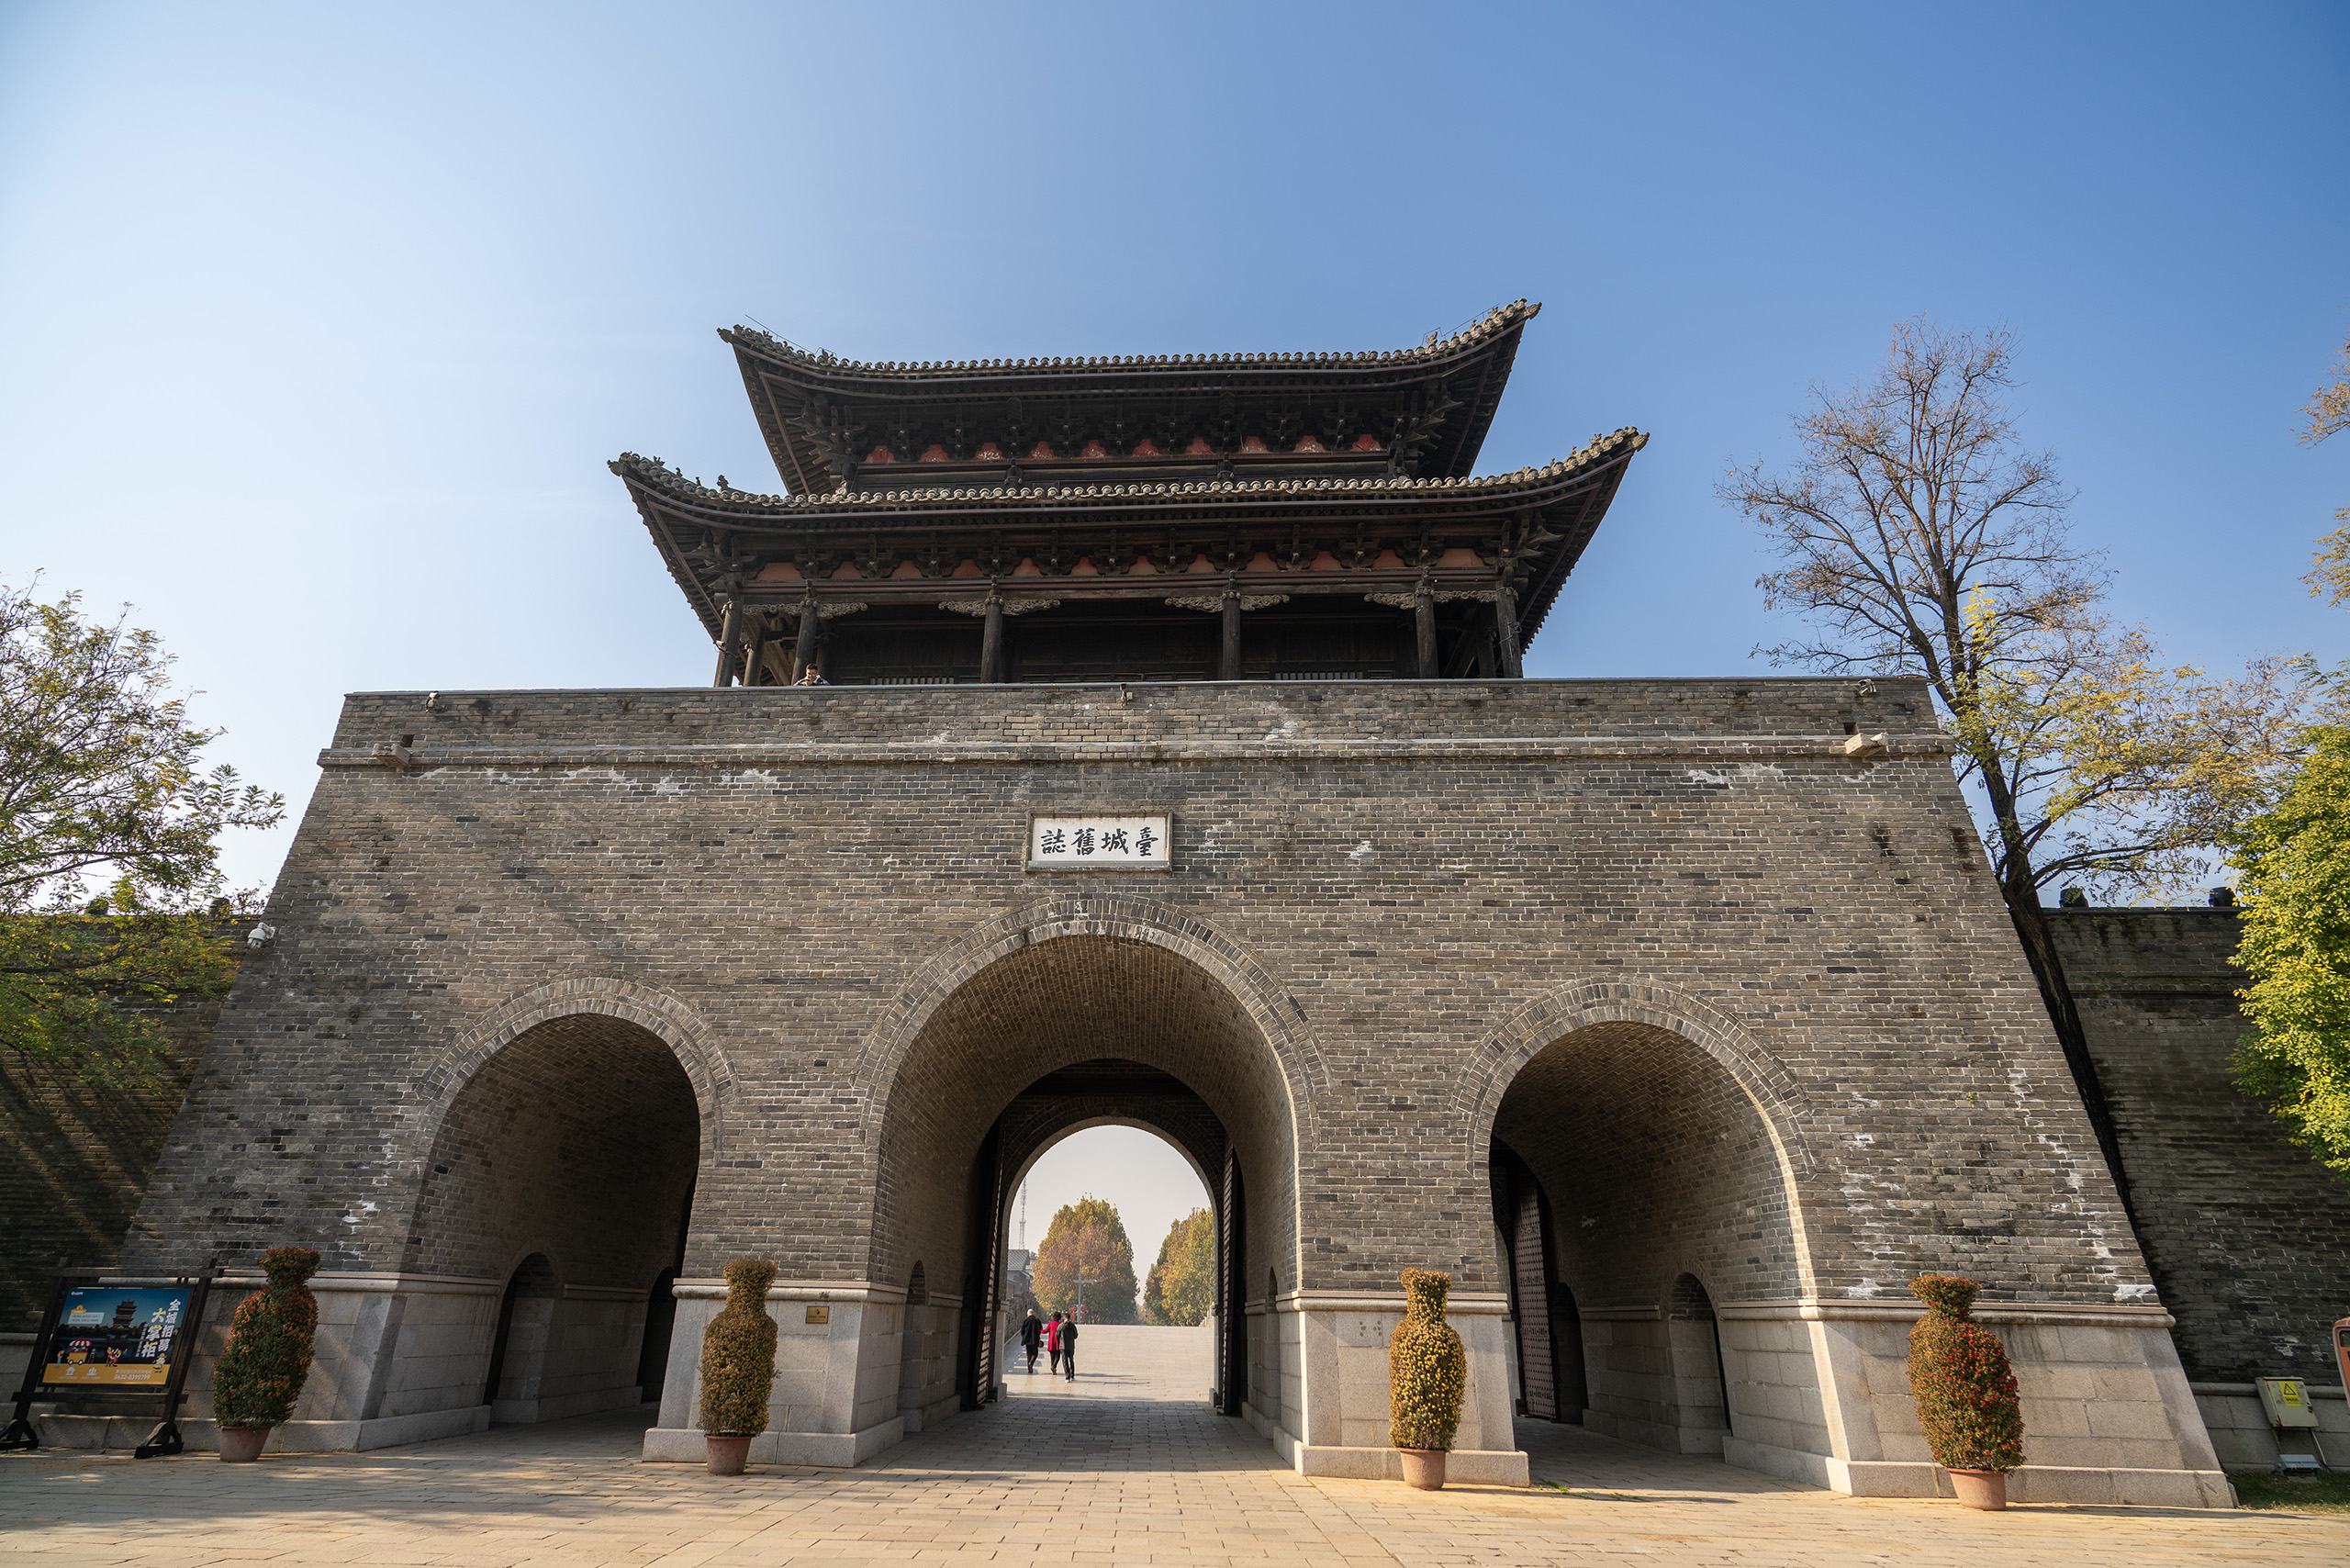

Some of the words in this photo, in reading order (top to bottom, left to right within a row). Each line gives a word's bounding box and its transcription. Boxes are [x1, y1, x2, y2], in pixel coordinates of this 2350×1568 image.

[140, 1307, 167, 1358] 大掌柜
[157, 1298, 182, 1352] 全城招募
